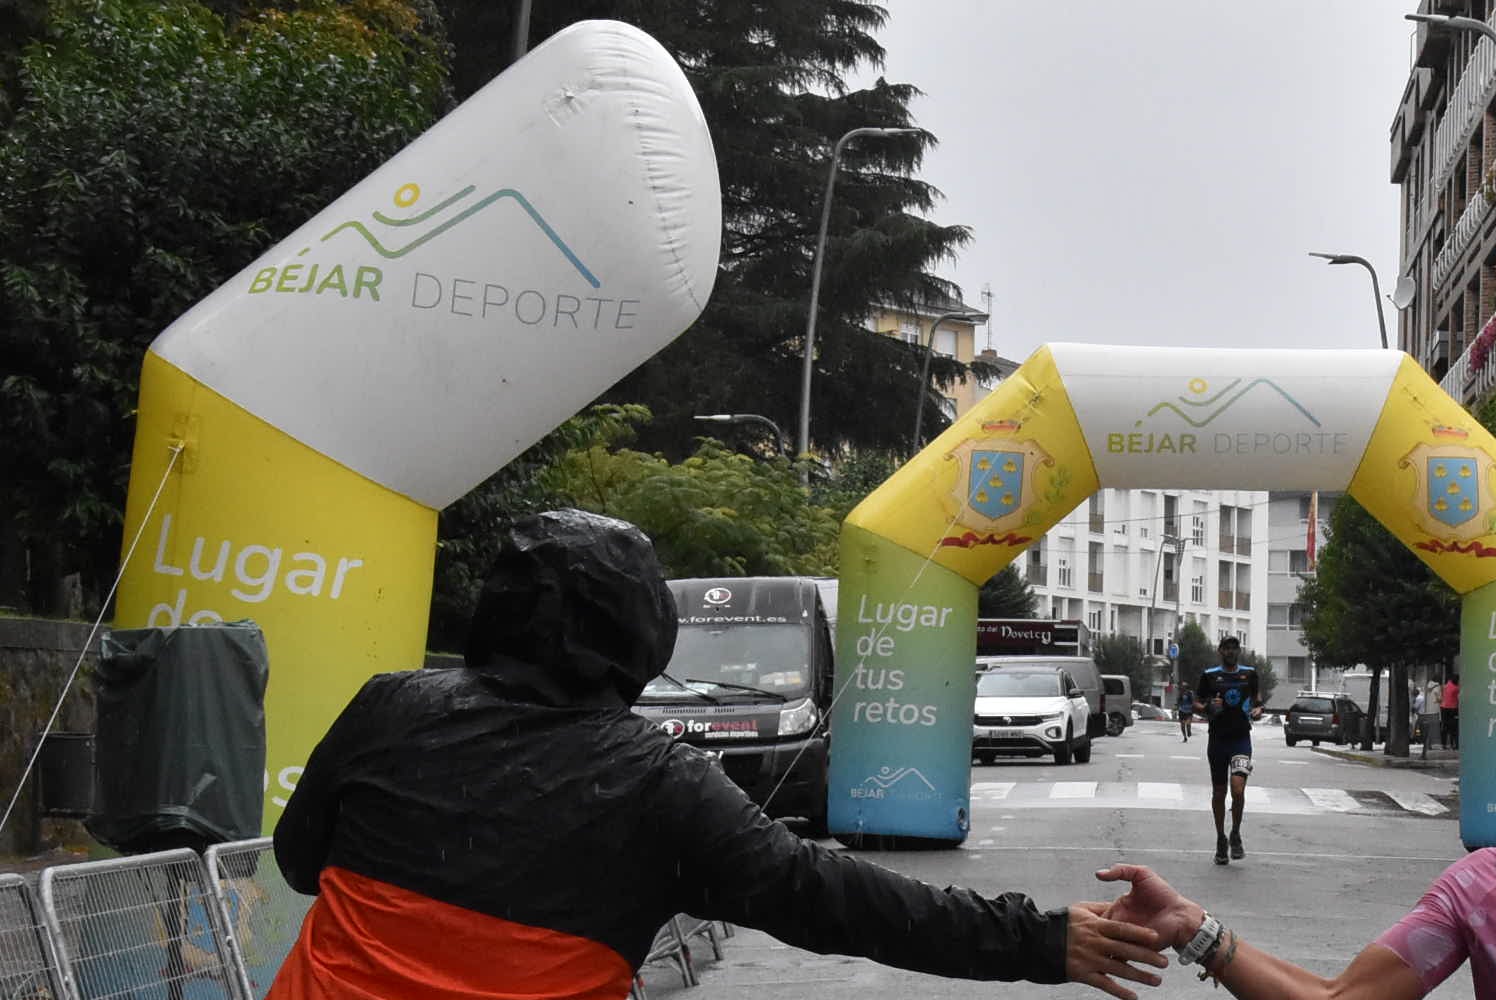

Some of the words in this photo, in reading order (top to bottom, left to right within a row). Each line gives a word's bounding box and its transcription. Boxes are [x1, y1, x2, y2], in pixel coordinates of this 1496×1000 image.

[248, 247, 382, 301] BÉJAR
[411, 272, 640, 330] DEPORTE
[1107, 420, 1197, 453] BÉJAR
[1213, 432, 1348, 455] DEPORTE
[153, 513, 363, 603] Lugar
[858, 594, 952, 632] Lugar
[857, 628, 895, 657] de
[856, 662, 904, 690] tus
[687, 719, 759, 733] forevent
[854, 698, 937, 726] retos
